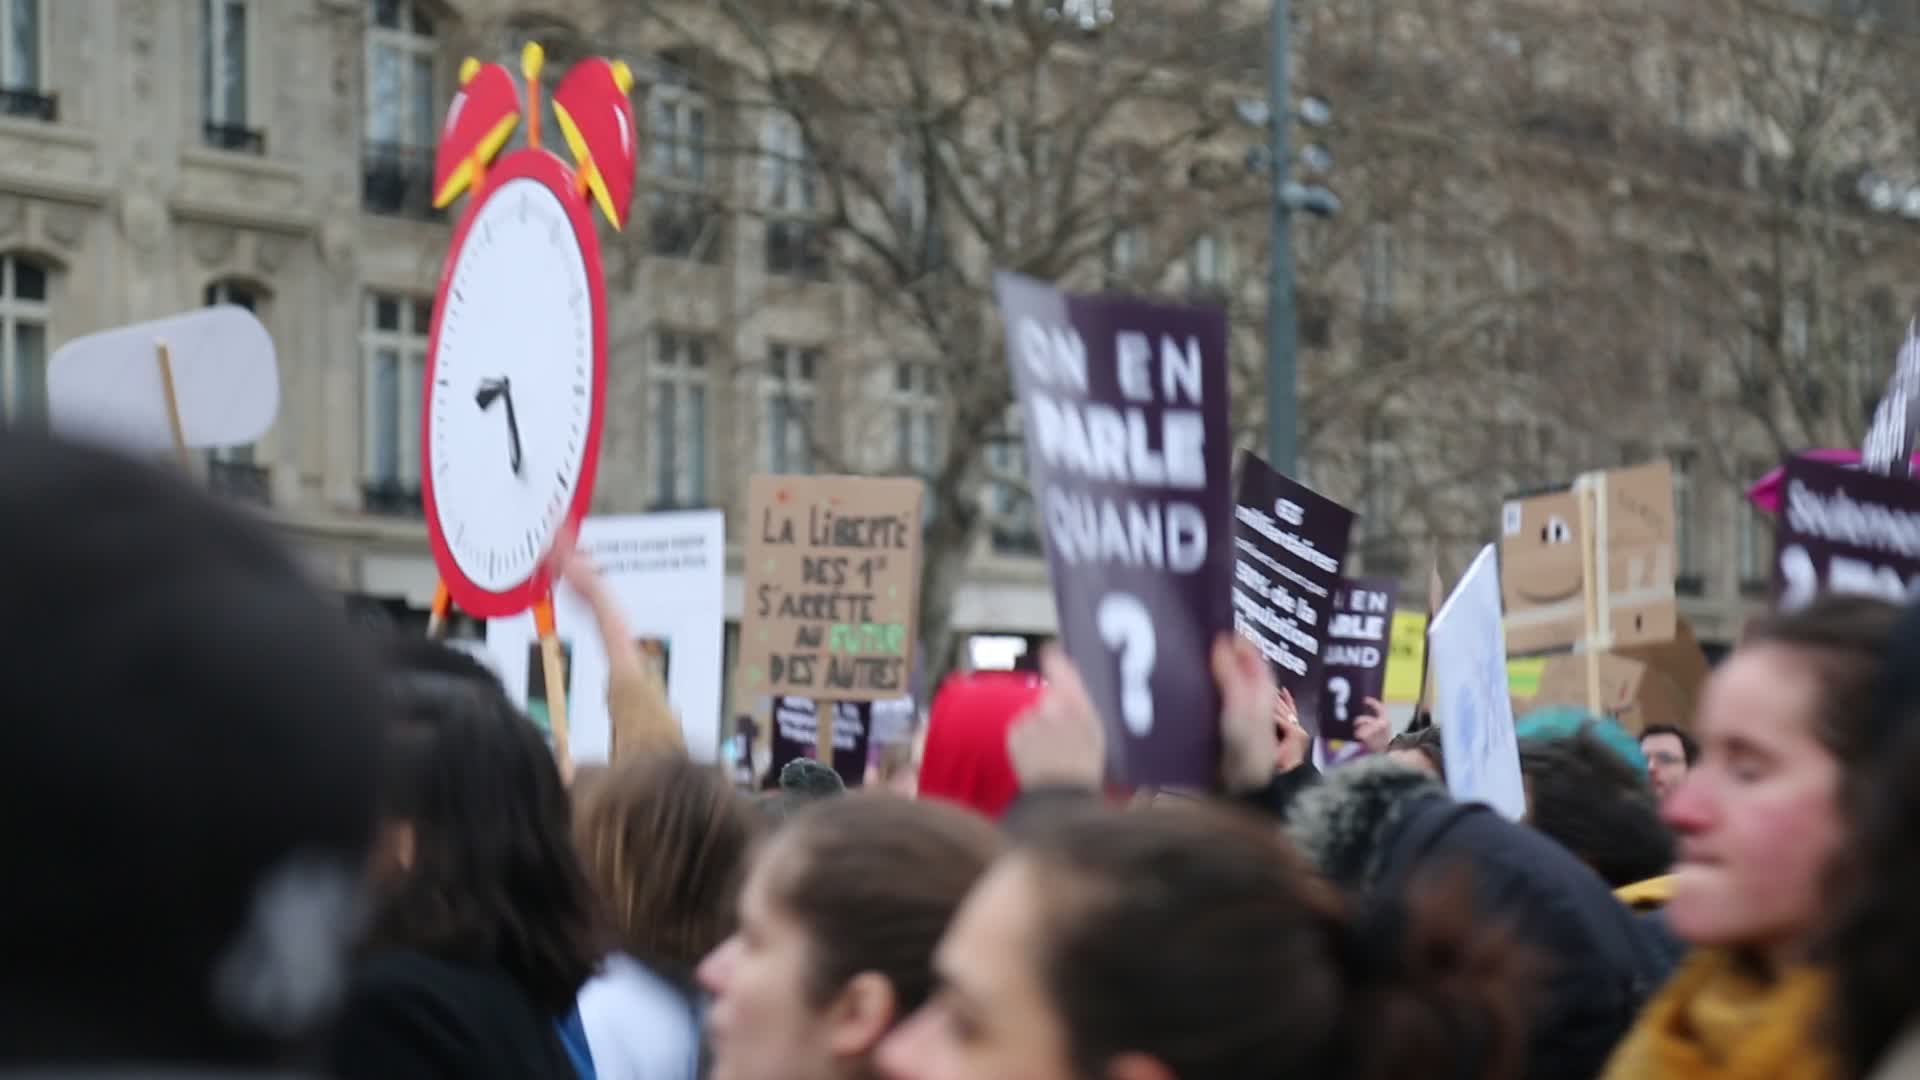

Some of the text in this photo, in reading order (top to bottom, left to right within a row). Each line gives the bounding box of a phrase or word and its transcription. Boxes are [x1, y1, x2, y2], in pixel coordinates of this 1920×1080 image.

[1116, 330, 1203, 404] EN
[1032, 394, 1206, 488] PARLE
[1048, 485, 1208, 572] QUAND
[803, 555, 848, 584] DES
[1270, 585, 1297, 613] de
[1296, 597, 1317, 626] la
[1350, 589, 1388, 612] EN
[769, 654, 905, 689] DES AUTRES
[1097, 592, 1156, 738] ?
[1327, 676, 1351, 721] ?
